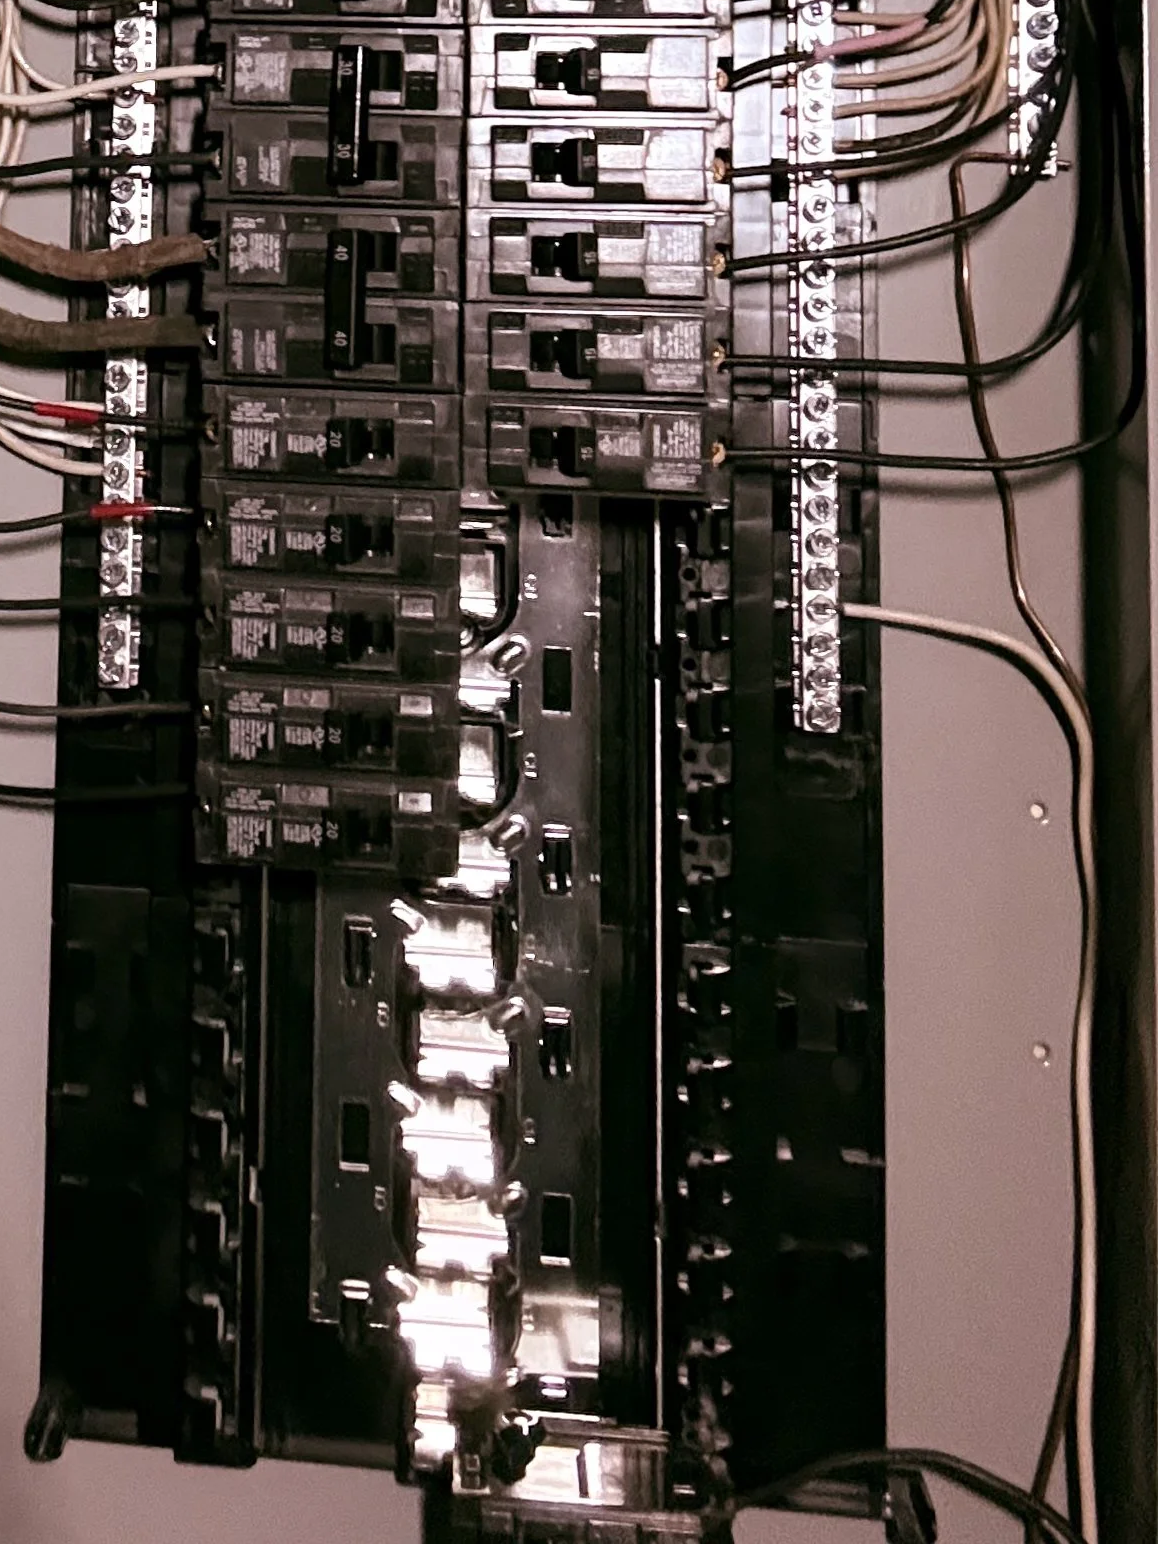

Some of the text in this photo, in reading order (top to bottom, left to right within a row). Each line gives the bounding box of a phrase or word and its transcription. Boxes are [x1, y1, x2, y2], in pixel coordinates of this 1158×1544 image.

[336, 143, 352, 159] 30
[334, 244, 349, 261] 40
[334, 330, 348, 347] 40
[329, 431, 342, 448] 20
[330, 525, 343, 543] 20
[330, 626, 344, 644] 20
[328, 727, 342, 744] 20
[326, 821, 339, 839] 20
